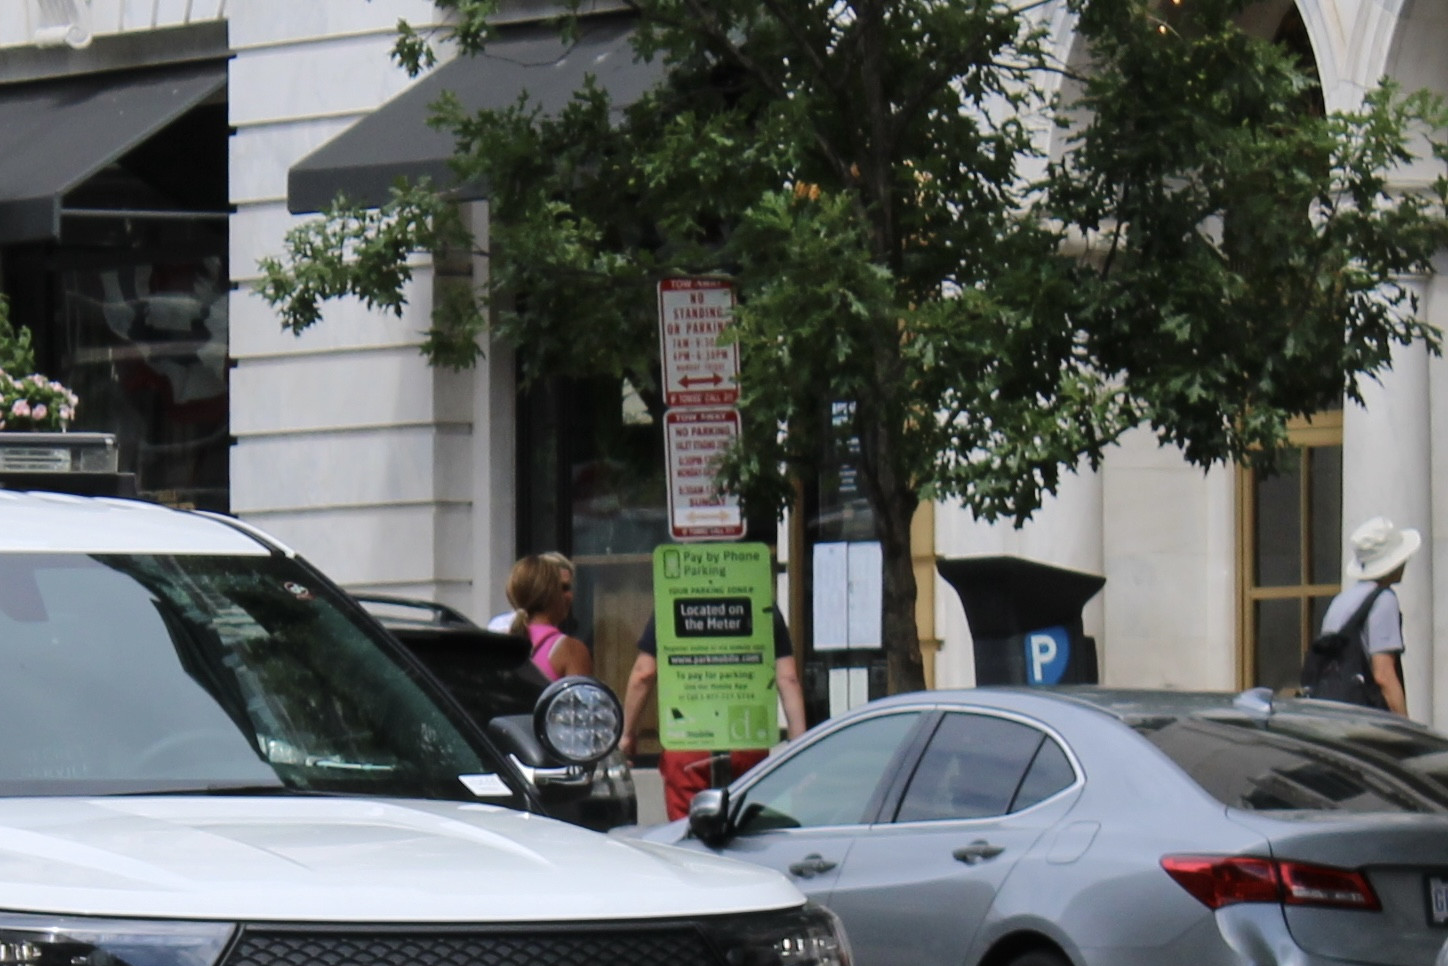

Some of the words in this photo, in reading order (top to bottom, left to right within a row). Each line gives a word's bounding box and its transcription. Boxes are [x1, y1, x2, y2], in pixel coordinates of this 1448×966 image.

[690, 292, 704, 304] NO
[667, 323, 680, 335] OR
[675, 426, 689, 437] NO
[683, 551, 702, 563] Pay
[706, 551, 720, 563] by
[723, 551, 760, 560] Phone
[684, 565, 726, 577] Parking
[680, 604, 725, 616] Located
[728, 605, 744, 615] on
[685, 619, 704, 630] the
[707, 617, 741, 630] Meter
[671, 654, 760, 665] www.parkmobile.com
[1030, 634, 1056, 681] P
[688, 672, 702, 680] pay
